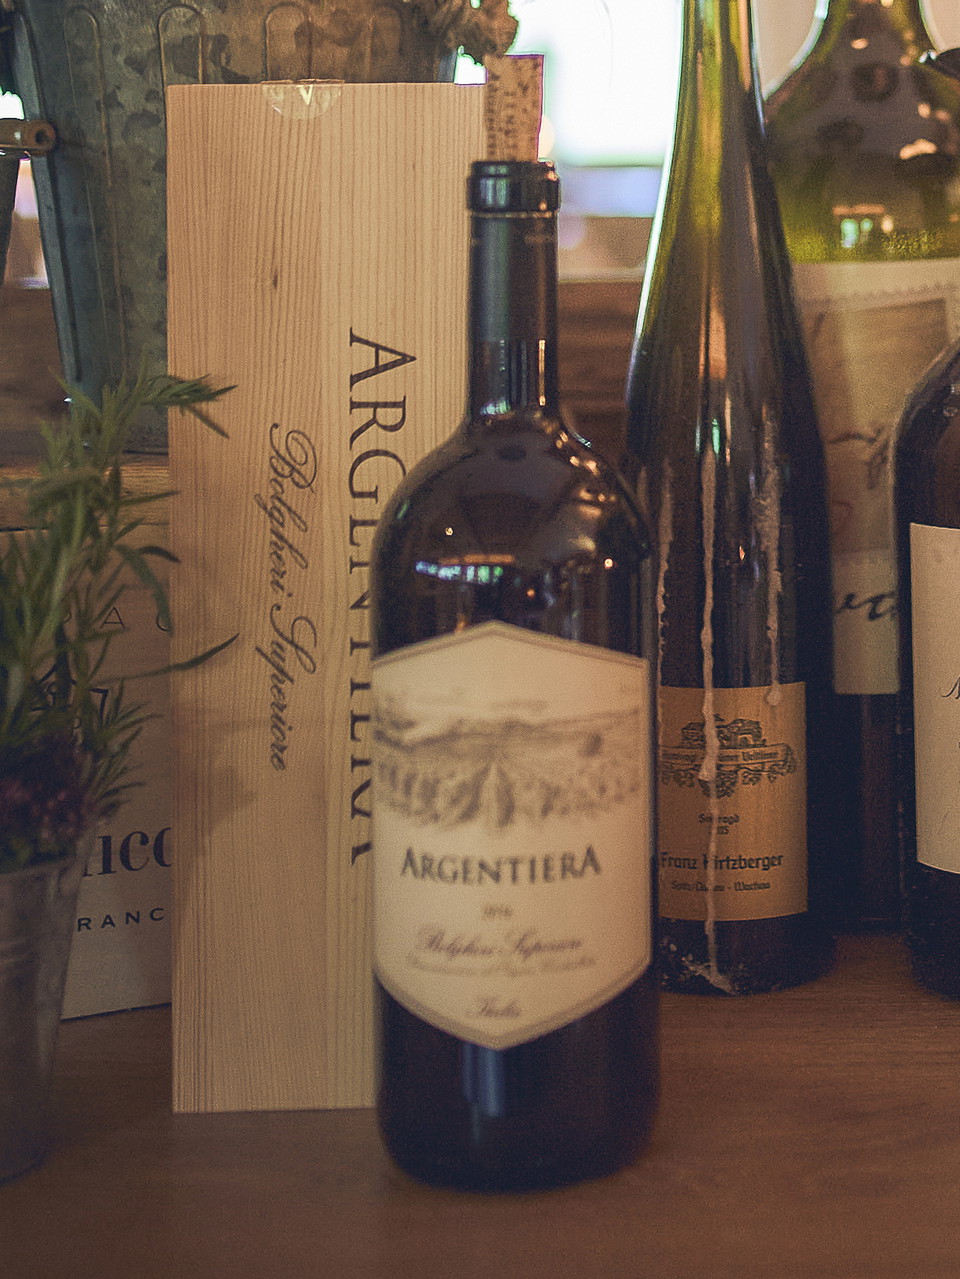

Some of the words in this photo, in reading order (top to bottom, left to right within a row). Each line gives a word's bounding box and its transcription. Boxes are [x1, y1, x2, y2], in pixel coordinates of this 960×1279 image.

[256, 423, 318, 598] Bolgheri
[255, 604, 318, 771] Superiore
[401, 845, 600, 885] ARGENTIERA
